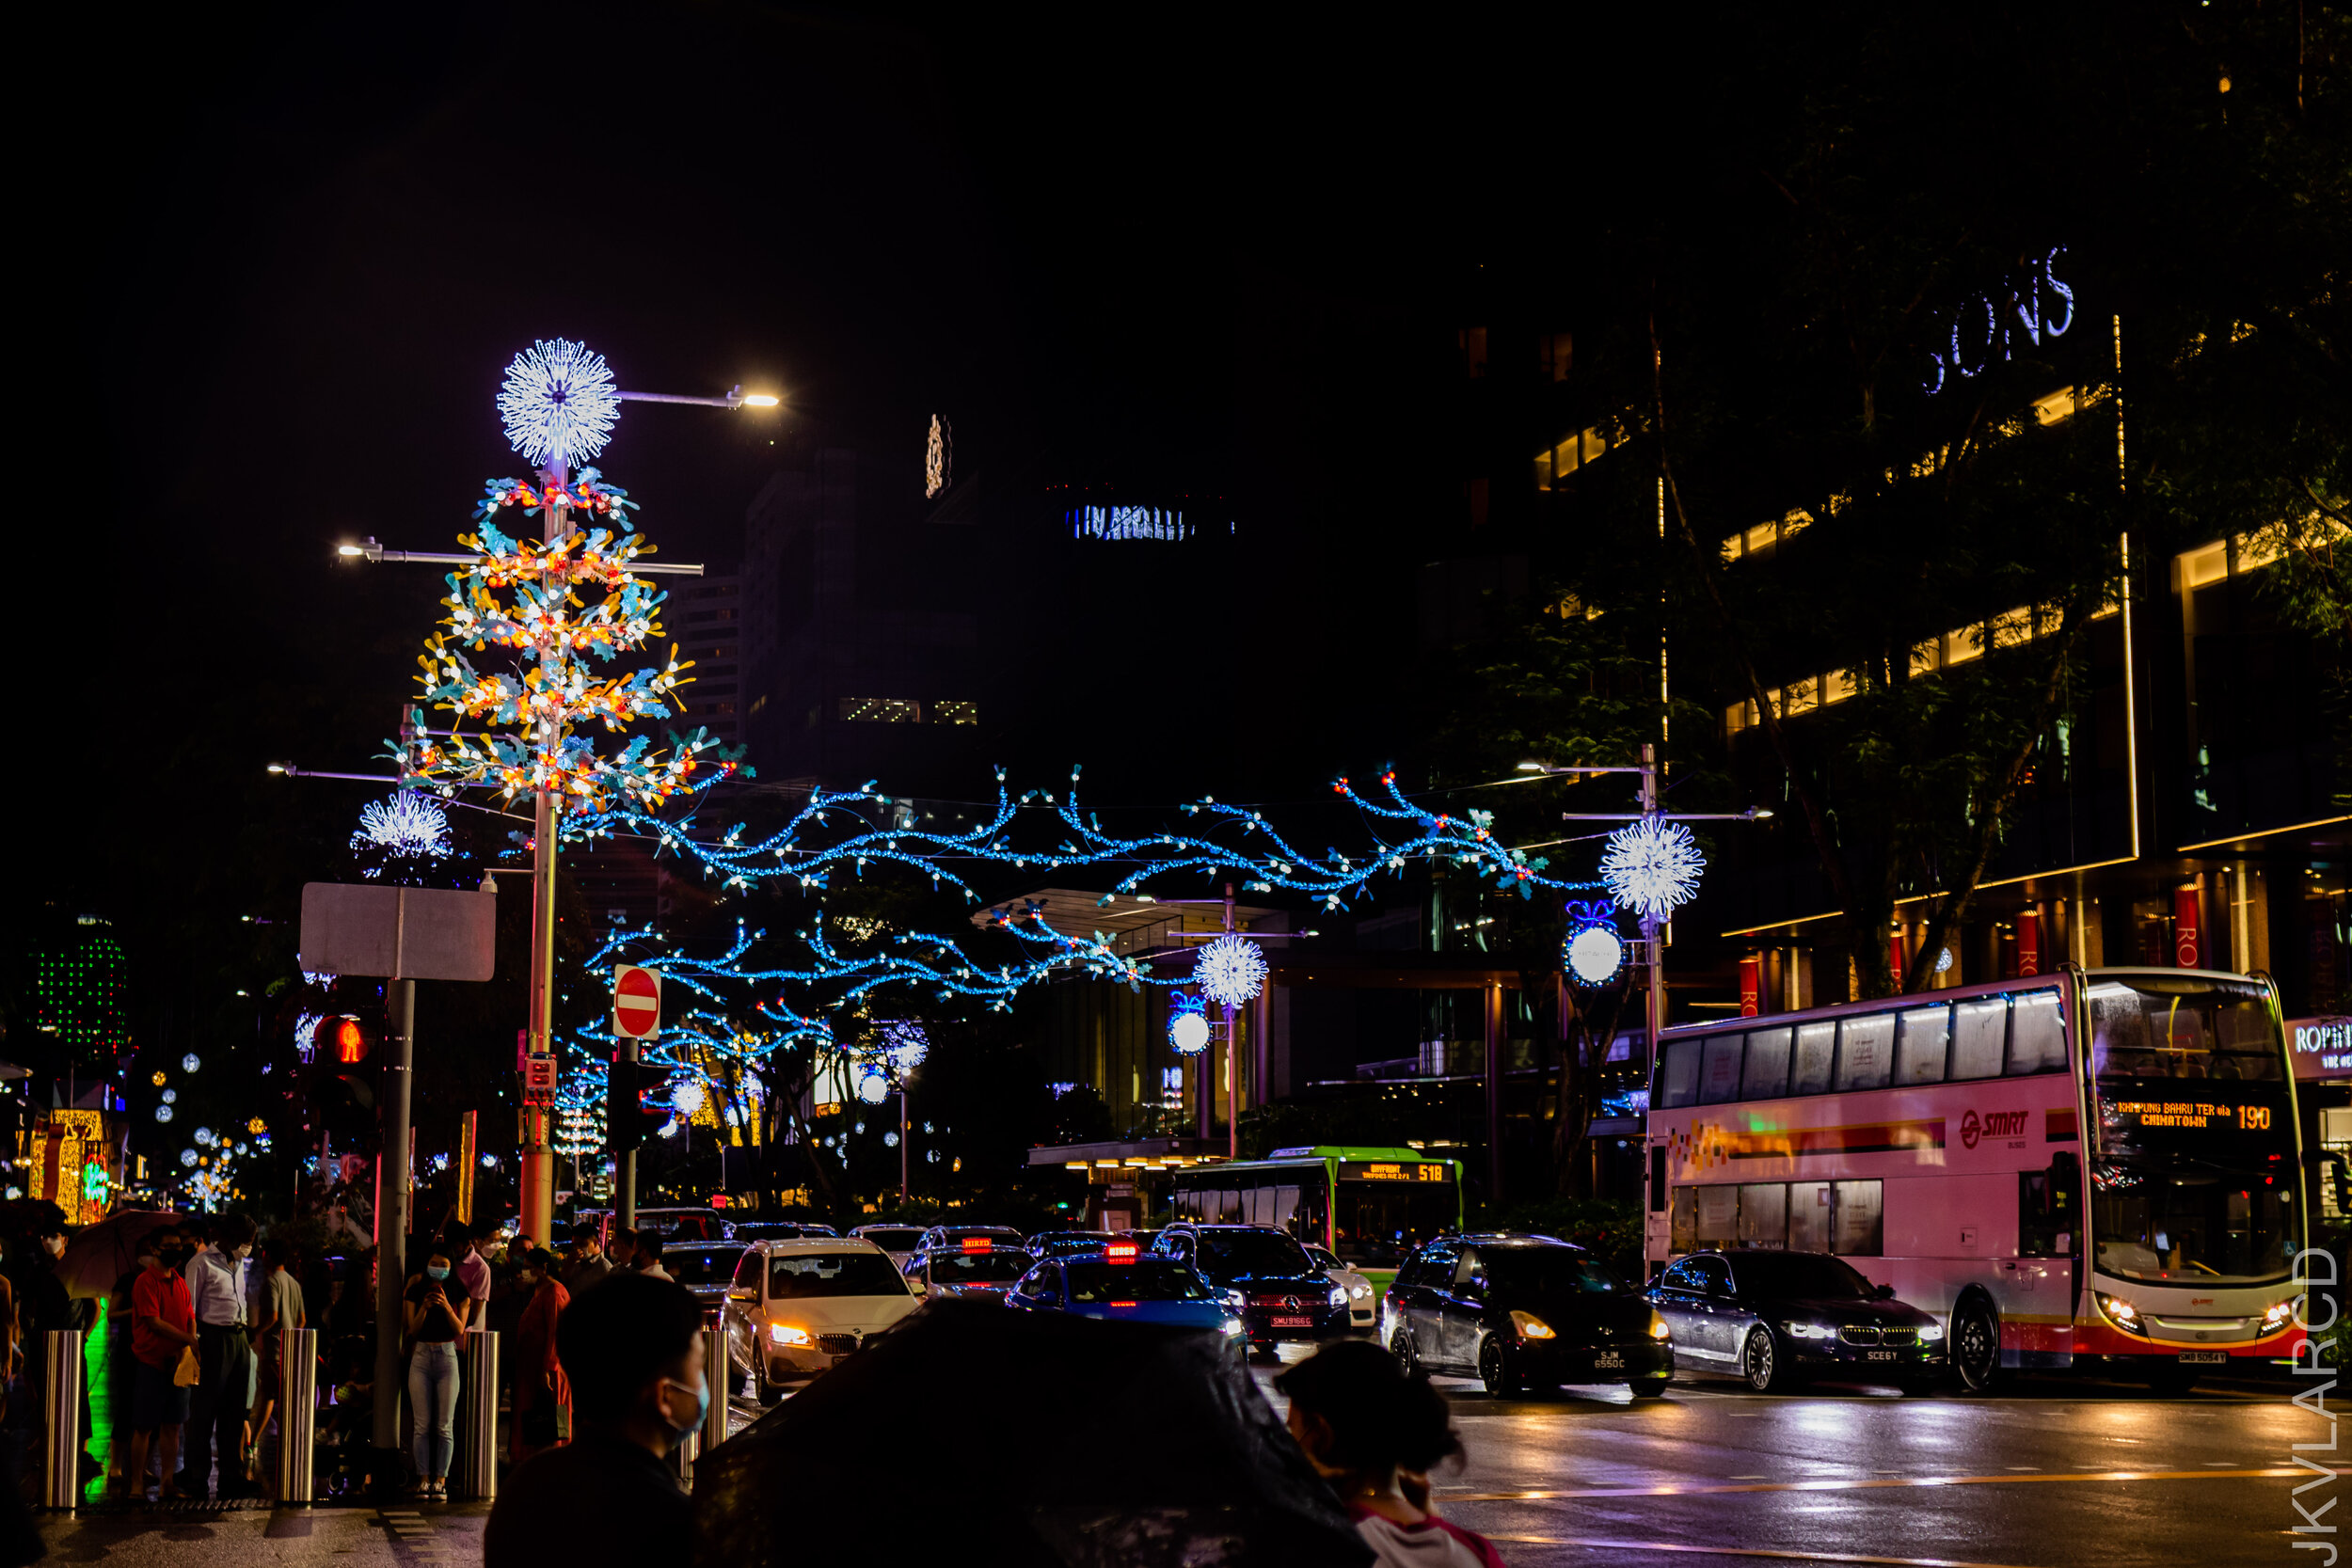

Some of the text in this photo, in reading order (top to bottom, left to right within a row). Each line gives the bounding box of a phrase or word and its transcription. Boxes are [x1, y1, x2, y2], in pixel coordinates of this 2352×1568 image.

[2177, 927, 2199, 967] RO
[2164, 1102, 2194, 1115] BAHRU
[2196, 1103, 2215, 1117] TER
[2217, 1104, 2232, 1117] via
[2237, 1105, 2271, 1129] 190
[1981, 1111, 2029, 1136] SMRT
[2140, 1115, 2207, 1128] CHINATOWN
[1419, 1164, 1443, 1181] 518
[1108, 1246, 1136, 1256] HIRED
